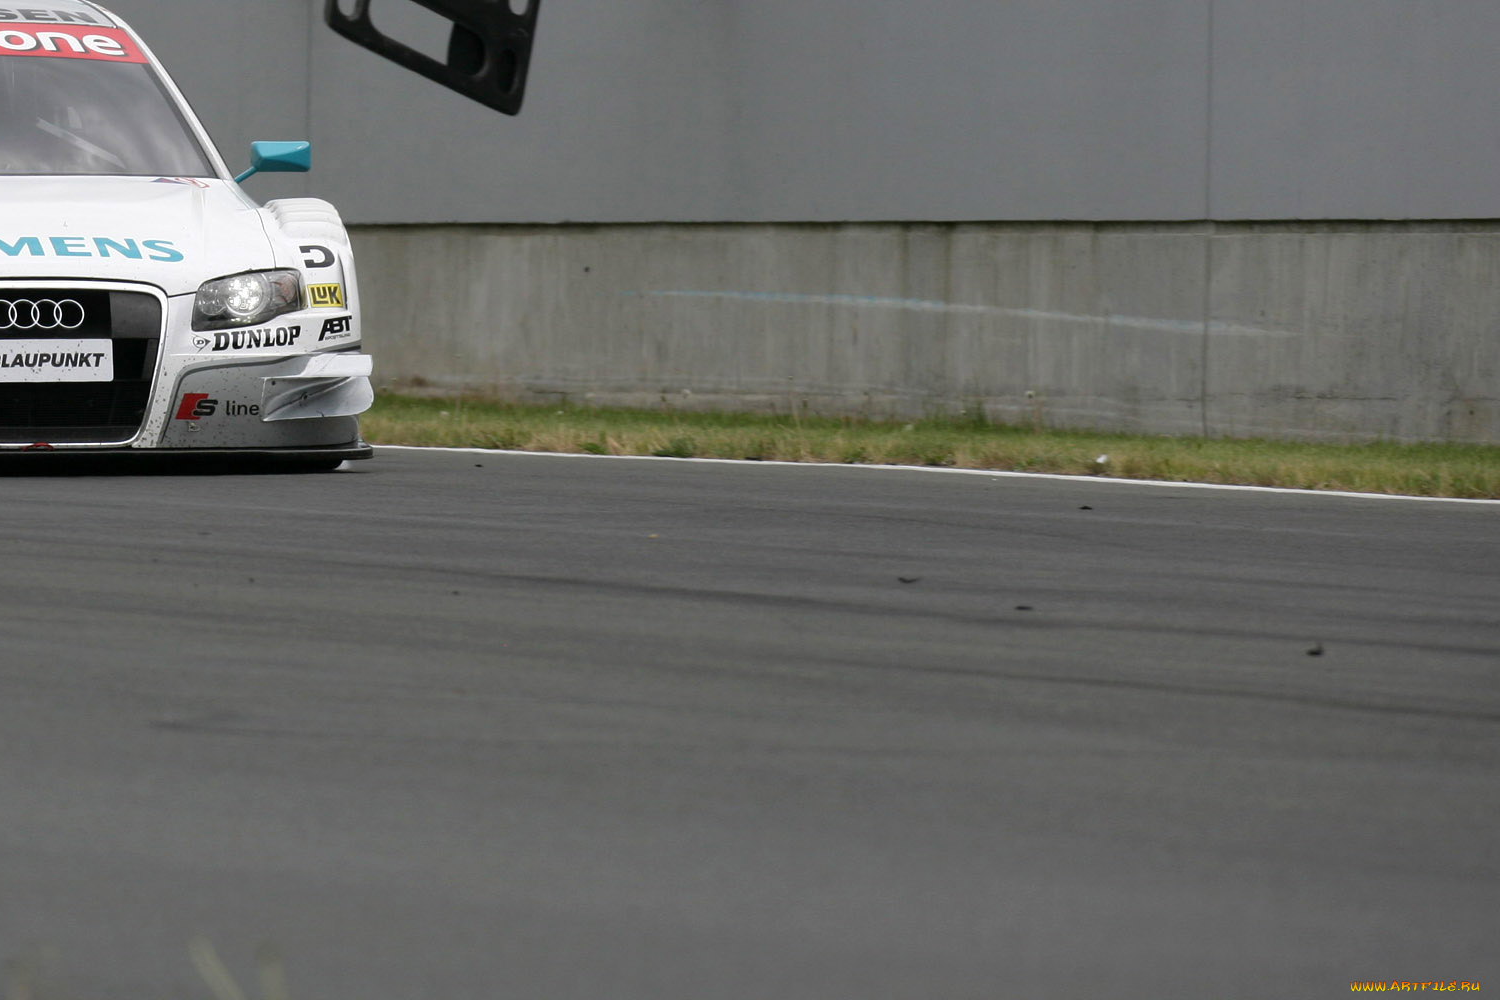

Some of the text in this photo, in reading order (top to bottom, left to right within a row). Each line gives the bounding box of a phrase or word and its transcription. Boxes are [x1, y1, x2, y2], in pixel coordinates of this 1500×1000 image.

[212, 325, 301, 351] DUNLOP
[318, 315, 352, 341] ABT
[193, 399, 260, 416] S line
